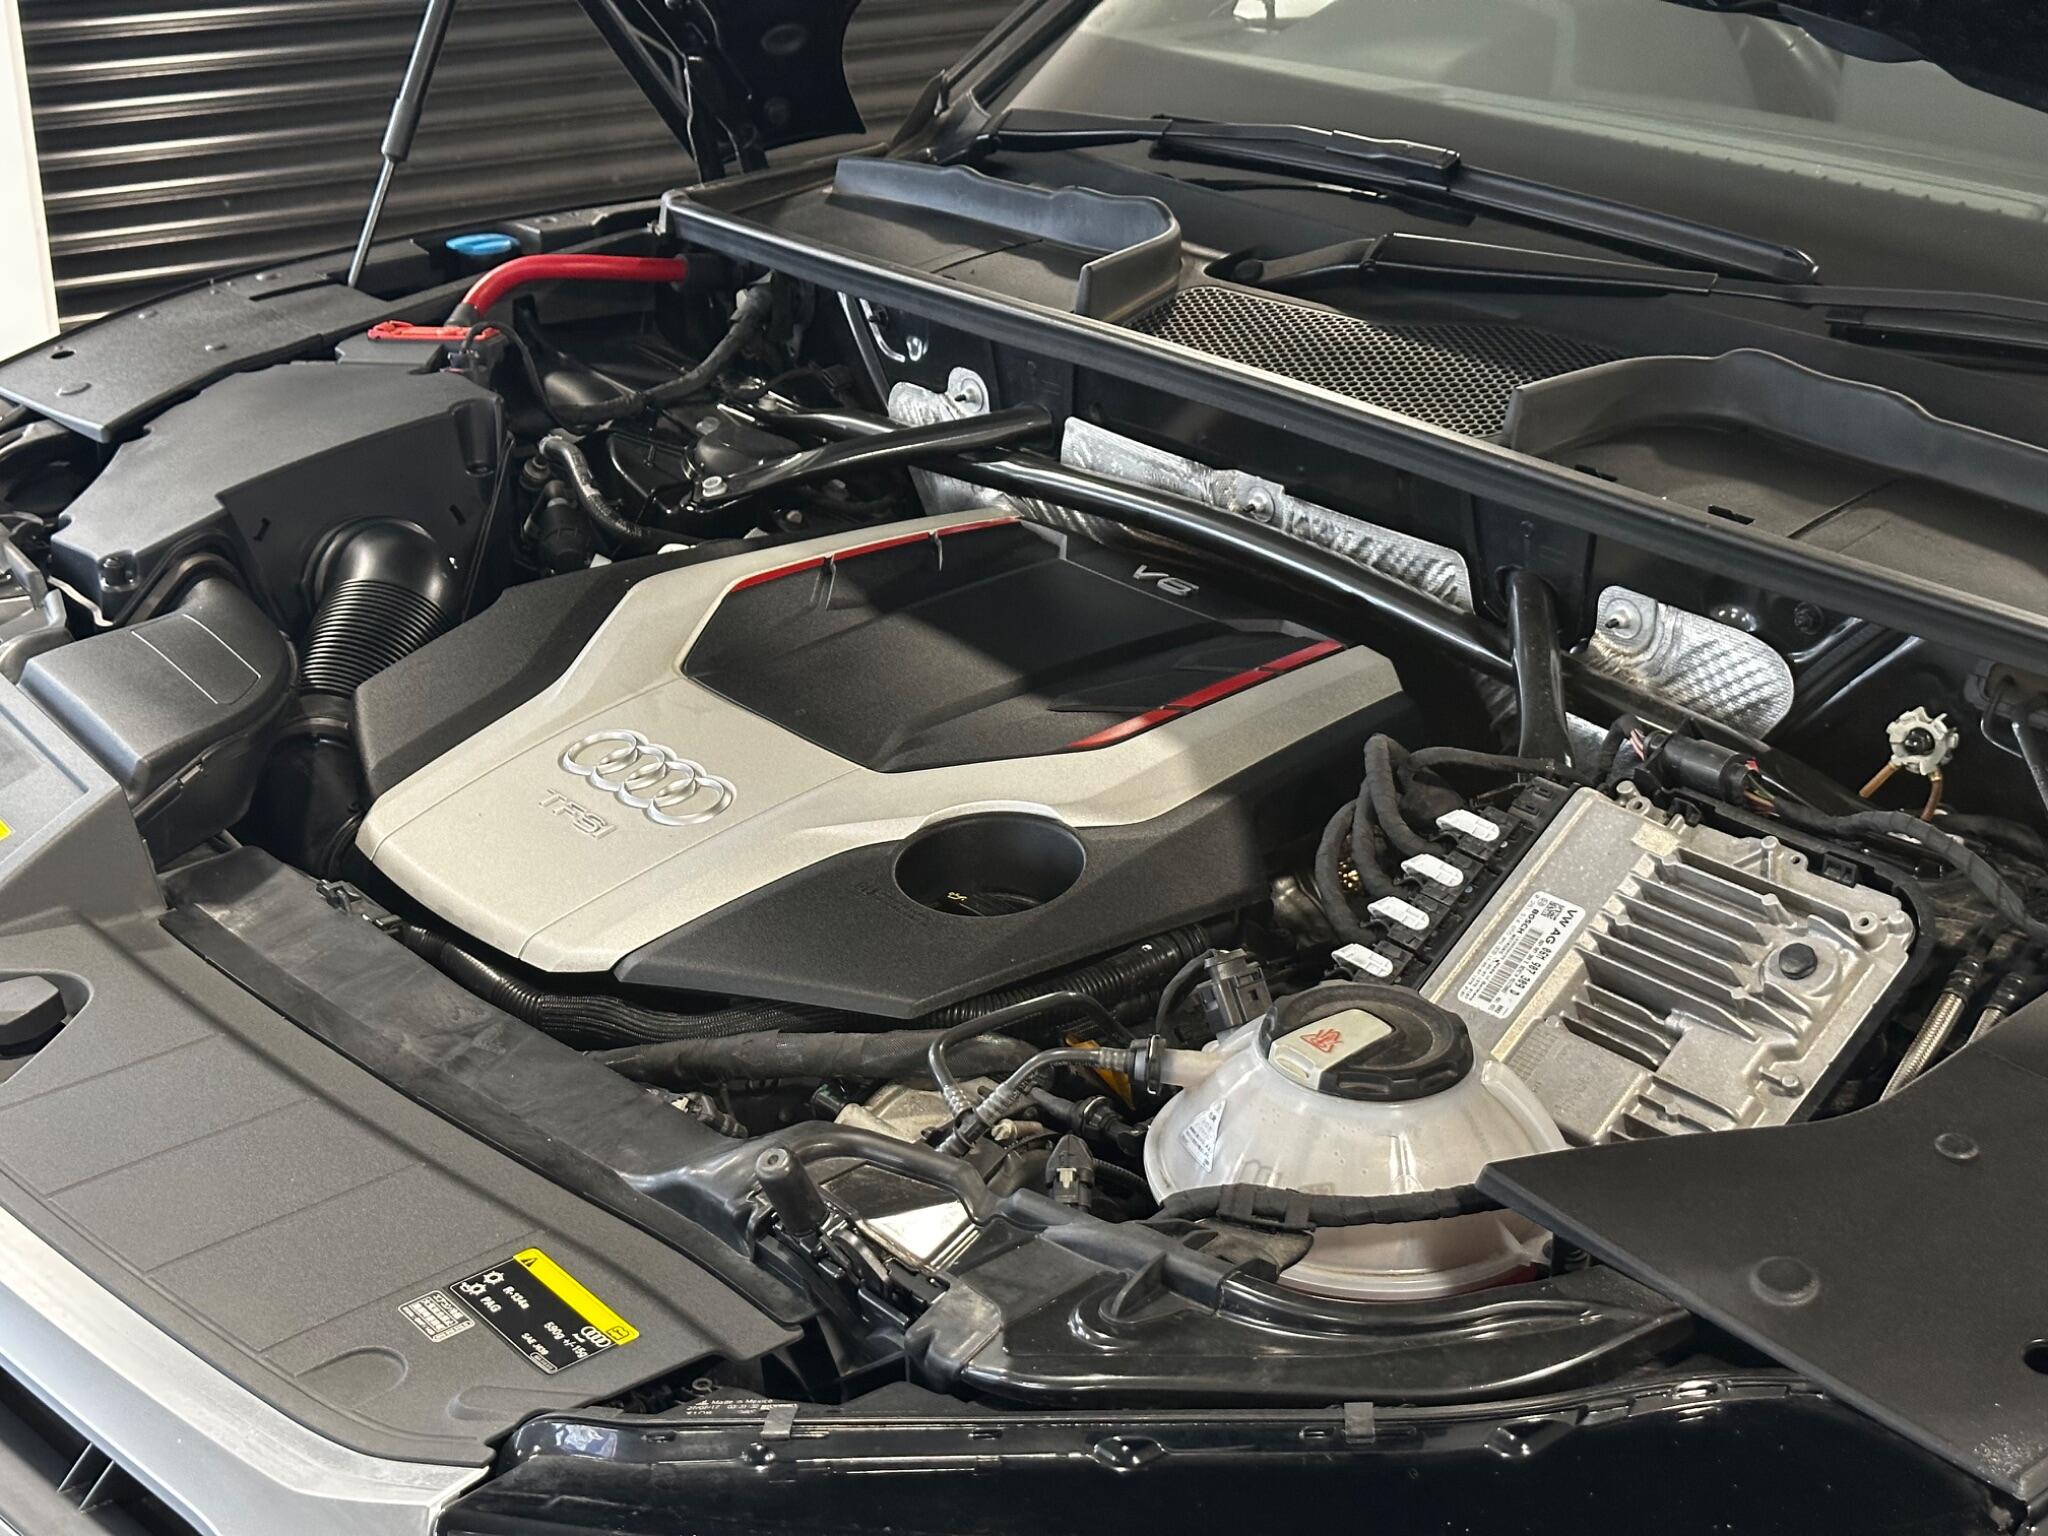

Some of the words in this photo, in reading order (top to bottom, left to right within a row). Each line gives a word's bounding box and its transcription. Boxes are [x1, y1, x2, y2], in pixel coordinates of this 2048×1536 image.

[1133, 564, 1200, 596] V6
[539, 788, 618, 840] TFSI
[1518, 909, 1539, 935] BOSCH
[1559, 909, 1578, 928] VW
[1544, 928, 1561, 945] AG
[480, 1296, 502, 1313] PAG
[520, 1332, 536, 1345] SAE
[503, 1286, 530, 1310] R-134a
[543, 1321, 566, 1341] 590g
